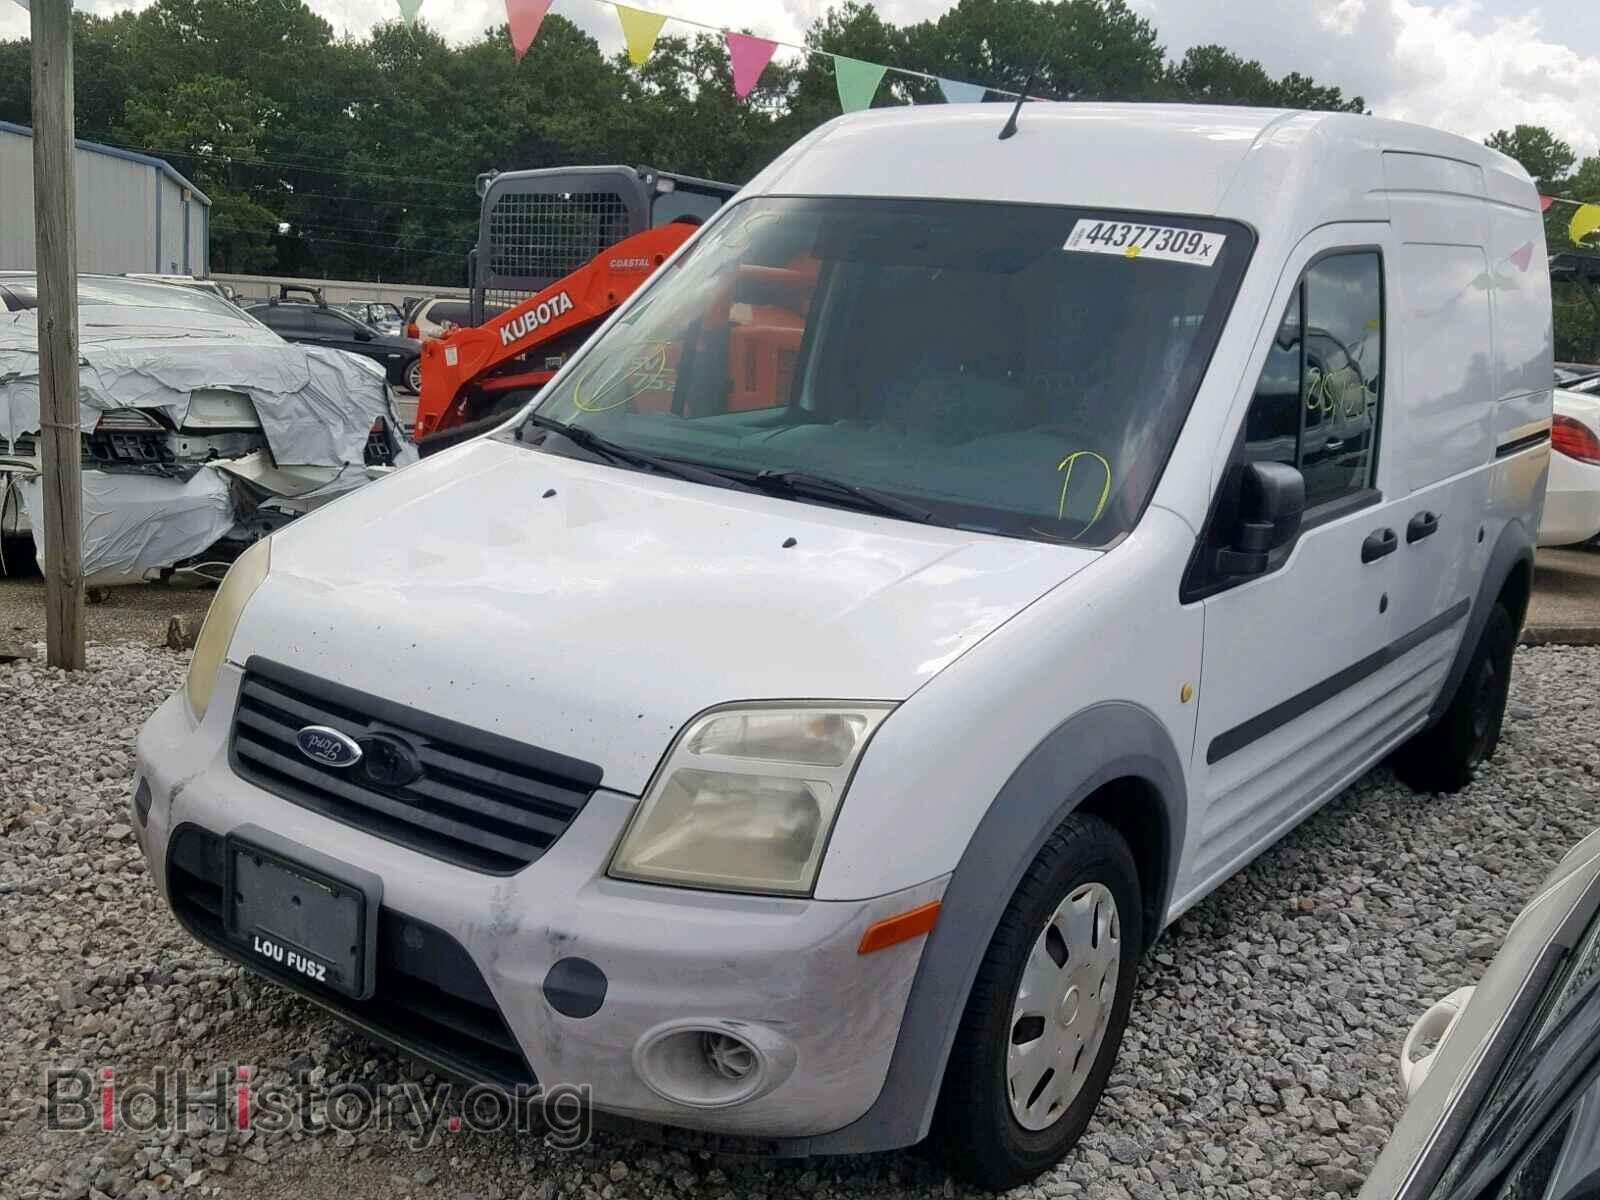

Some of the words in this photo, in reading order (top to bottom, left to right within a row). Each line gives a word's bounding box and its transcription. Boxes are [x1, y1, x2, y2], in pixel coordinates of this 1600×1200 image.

[608, 258, 650, 269] COASTAL
[499, 290, 575, 347] KUBOTA
[308, 733, 342, 761] Ford
[253, 936, 284, 963] LOU
[287, 951, 327, 982] FUSZ
